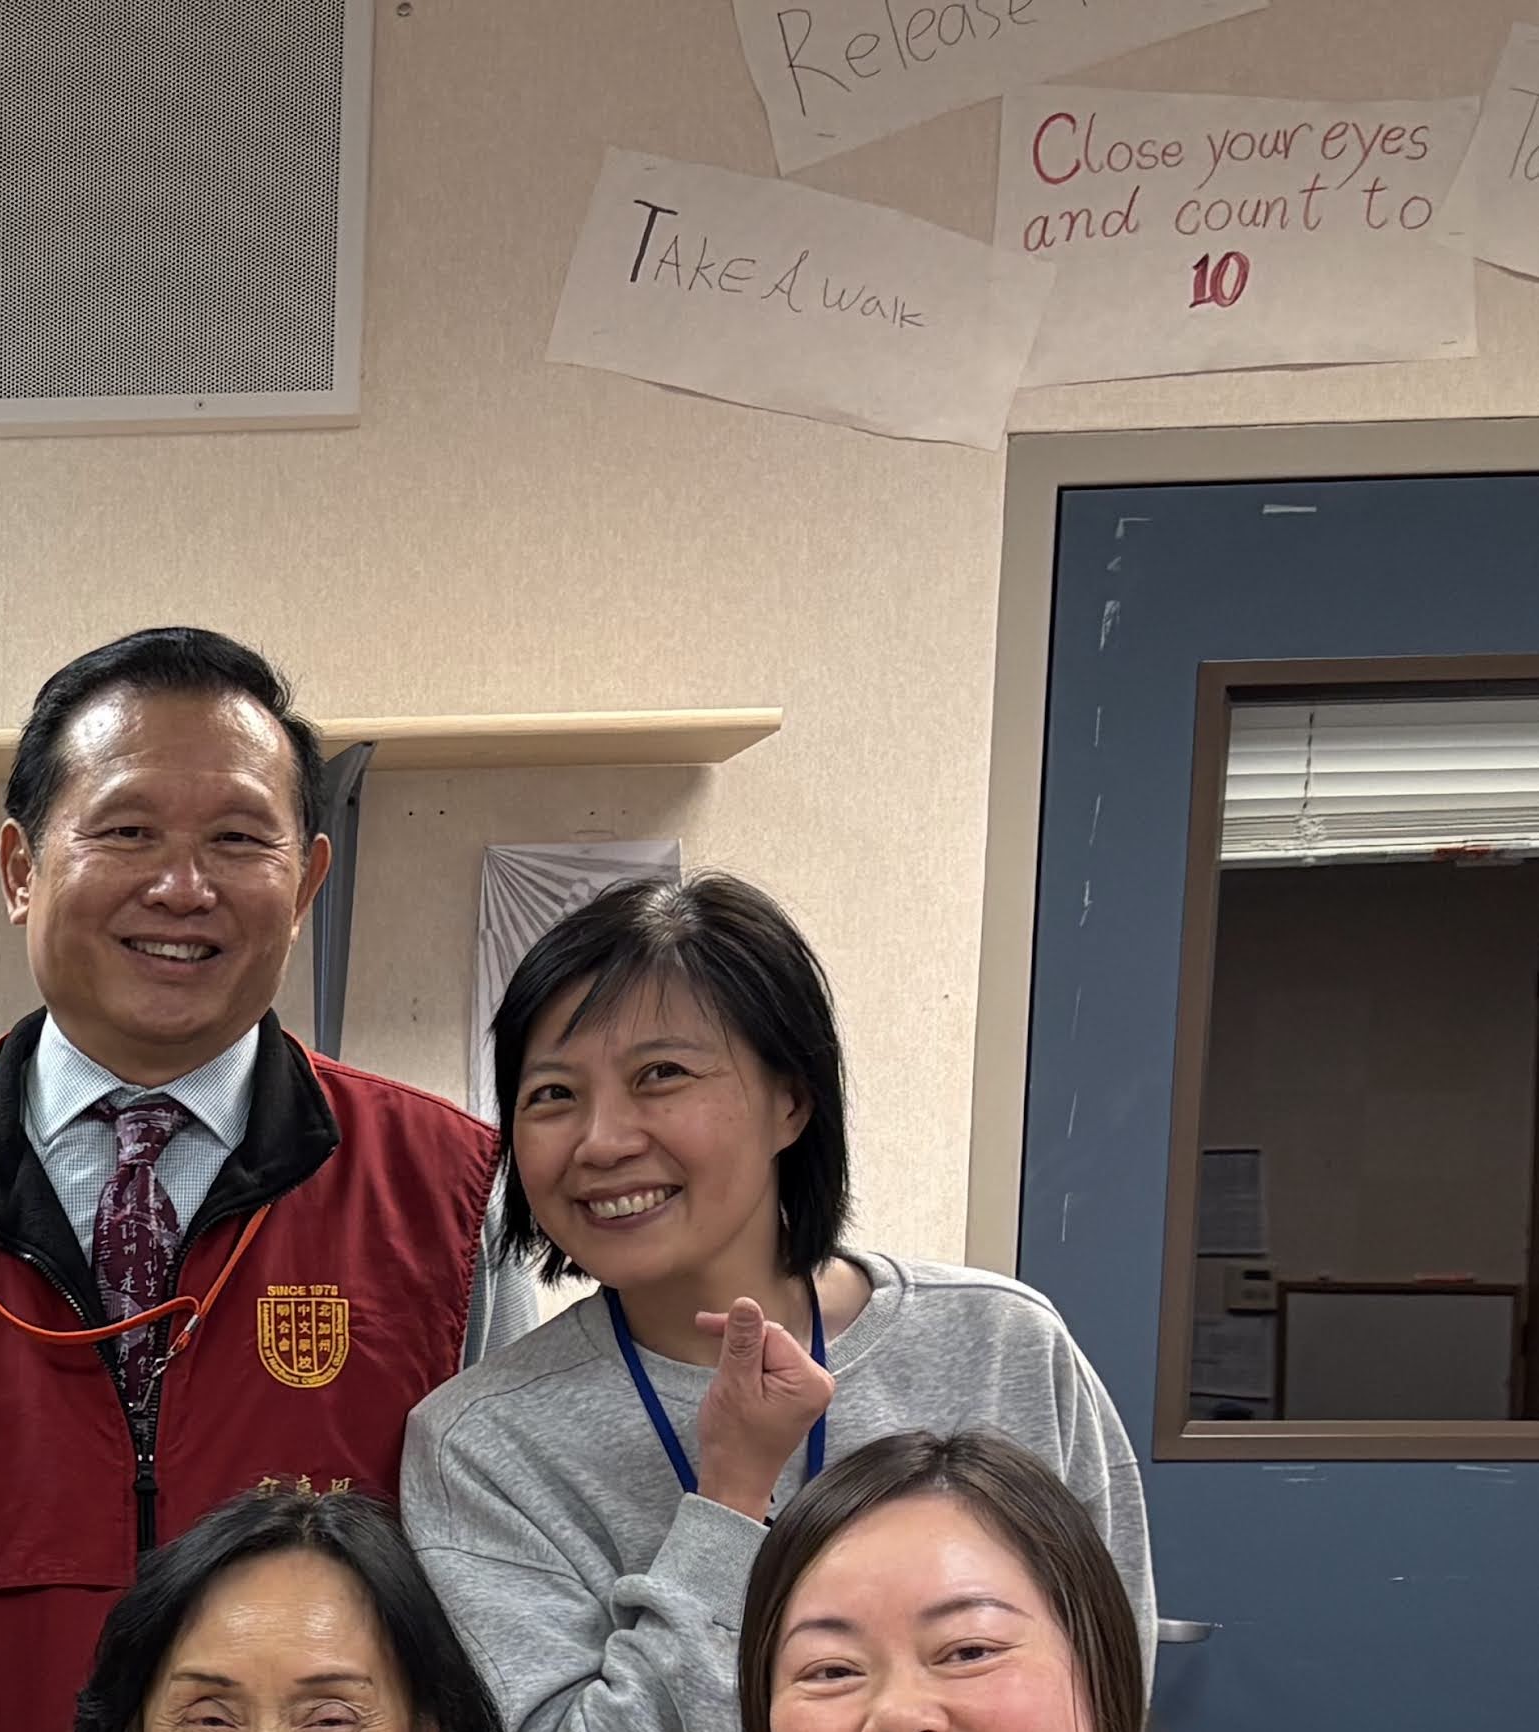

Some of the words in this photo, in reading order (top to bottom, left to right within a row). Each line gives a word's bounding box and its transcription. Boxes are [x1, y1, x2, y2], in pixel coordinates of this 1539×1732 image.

[1032, 111, 1183, 186] Close
[1207, 123, 1314, 190] your
[1320, 119, 1430, 190] eyes
[1024, 185, 1138, 253] and
[1175, 181, 1325, 237] count
[1364, 183, 1434, 232] to
[761, 250, 810, 313] A
[1189, 252, 1251, 309] 10
[267, 1285, 307, 1296] SINCE
